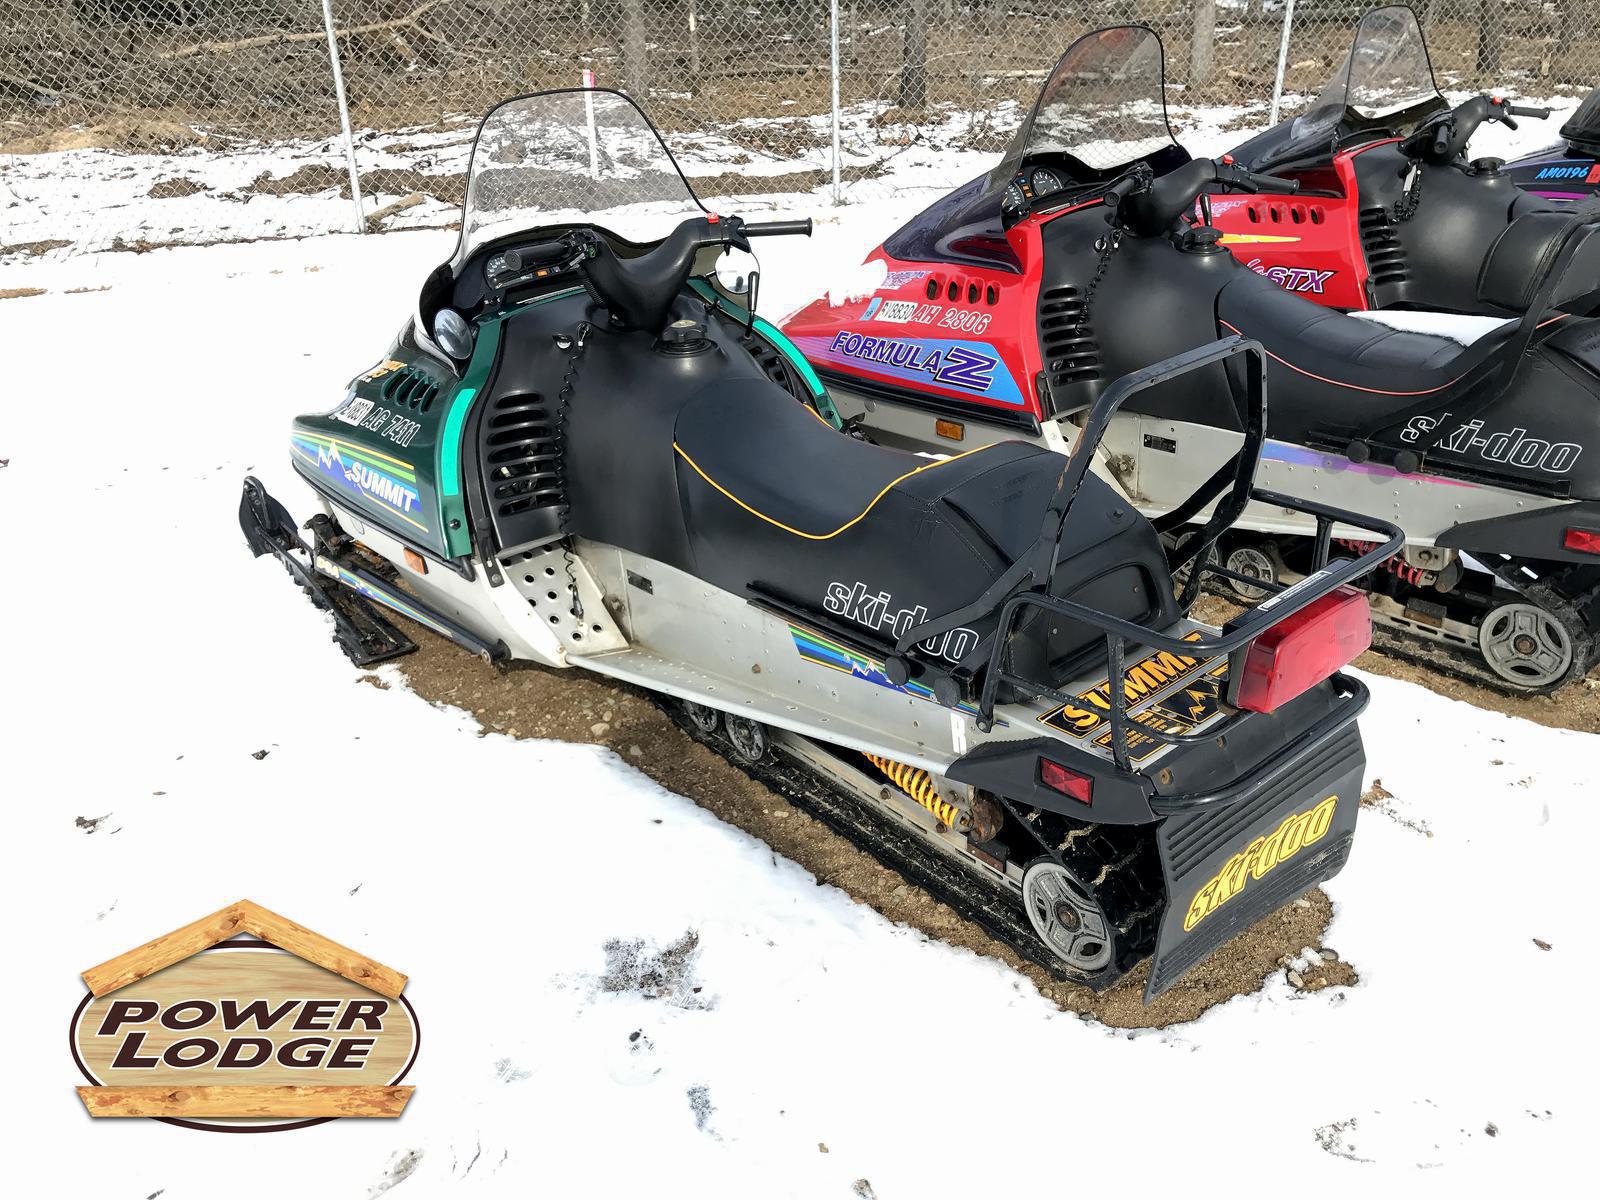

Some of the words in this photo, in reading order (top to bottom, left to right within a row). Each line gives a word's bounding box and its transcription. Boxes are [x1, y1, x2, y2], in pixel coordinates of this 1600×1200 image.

[1535, 166, 1590, 180] AM0196
[1266, 267, 1335, 293] STX
[911, 303, 942, 325] AH
[937, 307, 993, 335] 2806
[829, 330, 943, 374] FORMULA
[933, 346, 1000, 392] Z
[360, 406, 391, 432] AG
[1399, 412, 1583, 473] ski-doo
[350, 461, 417, 513] SUMMIT
[950, 712, 967, 755] R
